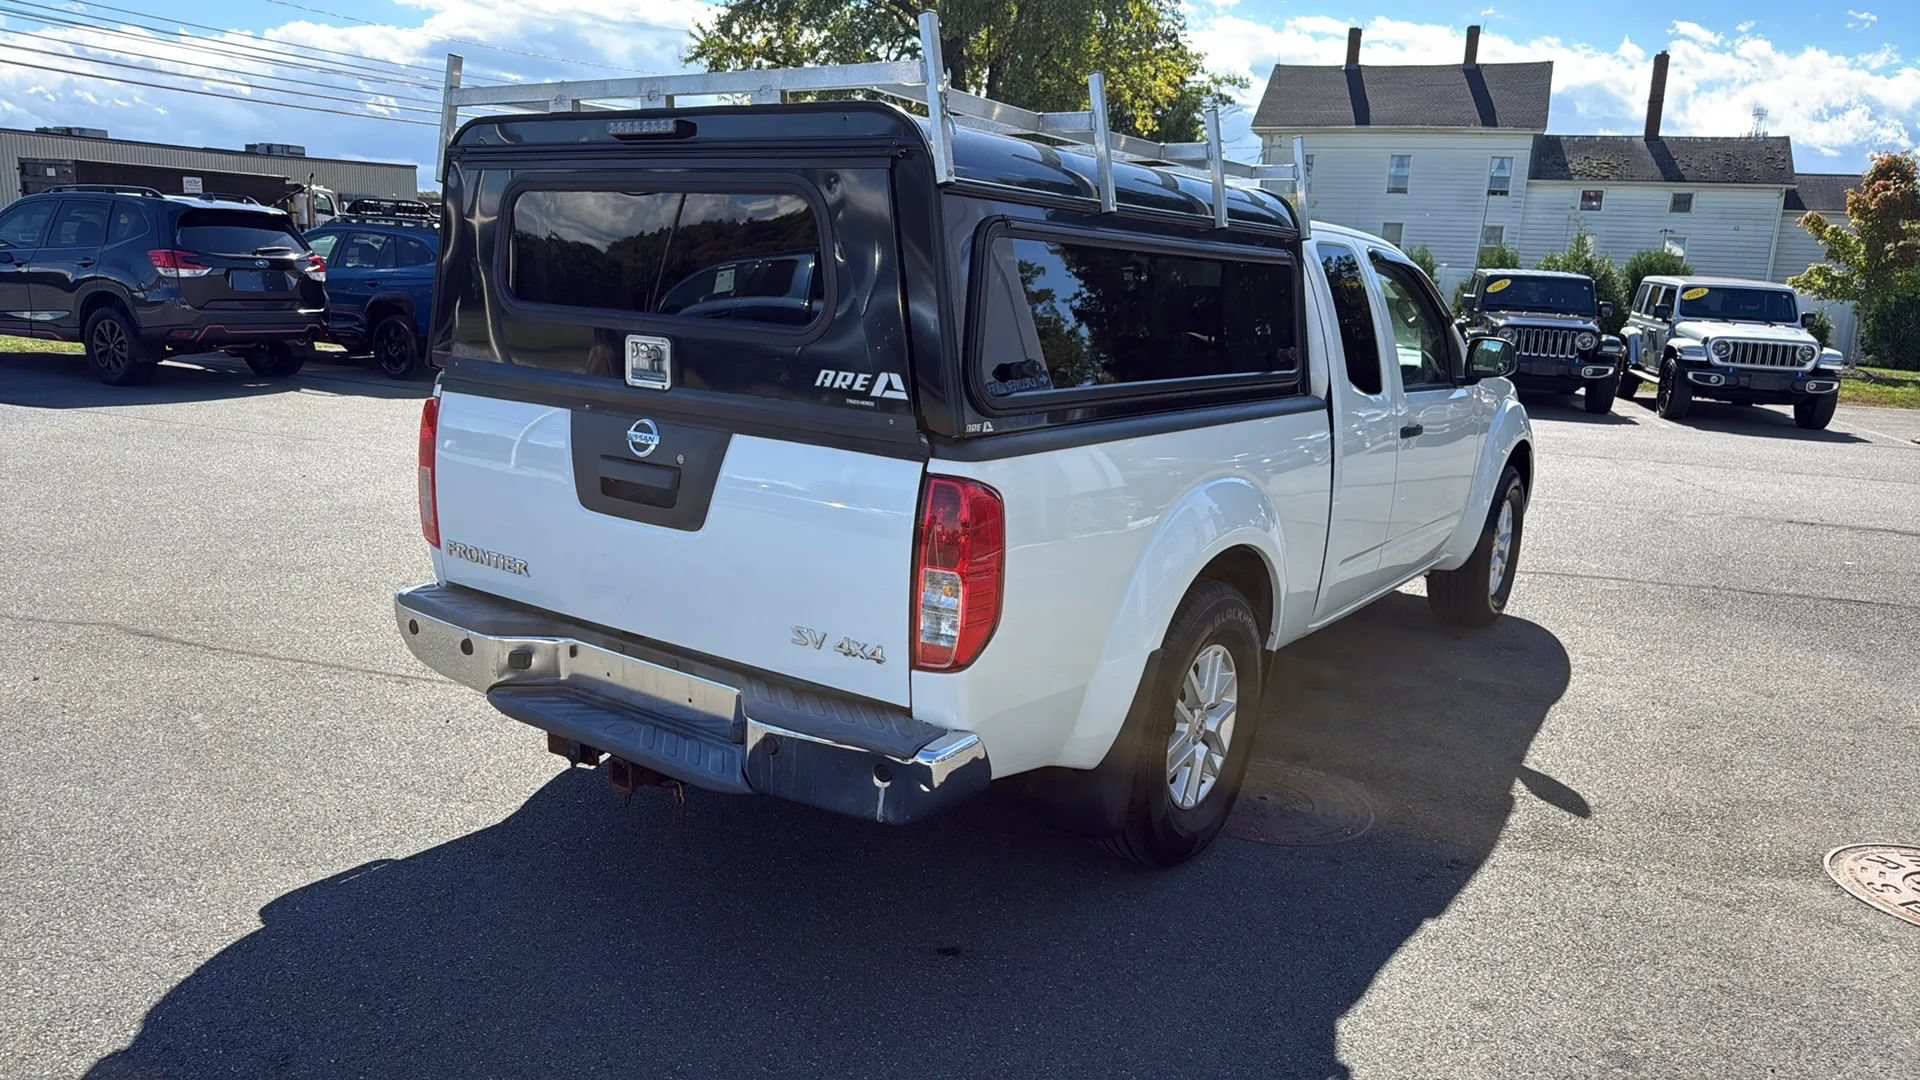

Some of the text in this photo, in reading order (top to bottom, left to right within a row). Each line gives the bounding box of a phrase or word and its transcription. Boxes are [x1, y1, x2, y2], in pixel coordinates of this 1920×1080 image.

[628, 431, 656, 443] NISSAN
[447, 539, 531, 577] FRONTIER
[790, 624, 827, 650] SV
